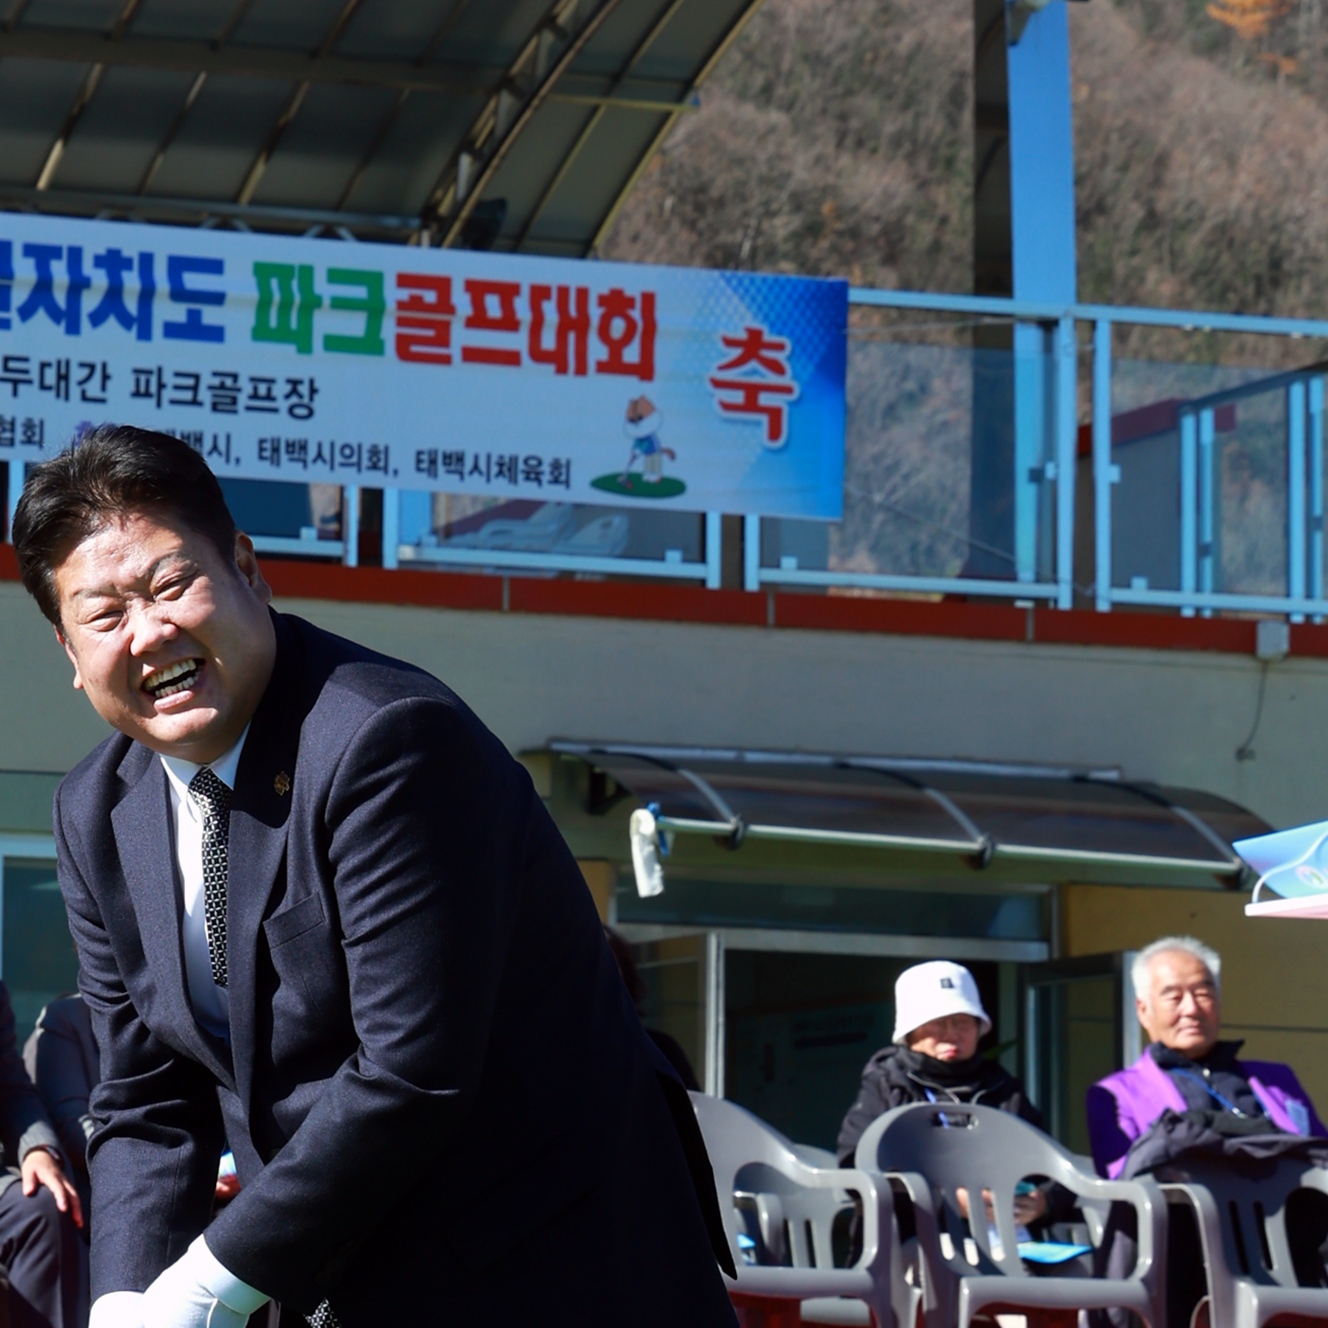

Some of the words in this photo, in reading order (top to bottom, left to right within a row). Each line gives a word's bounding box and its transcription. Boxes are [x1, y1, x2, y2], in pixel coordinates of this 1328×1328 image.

[130, 365, 320, 420] 파크골프장
[709, 327, 798, 443] 축
[158, 429, 240, 467] 백시,
[257, 436, 400, 478] 태백시의회,
[414, 448, 572, 489] 태백시체육회
